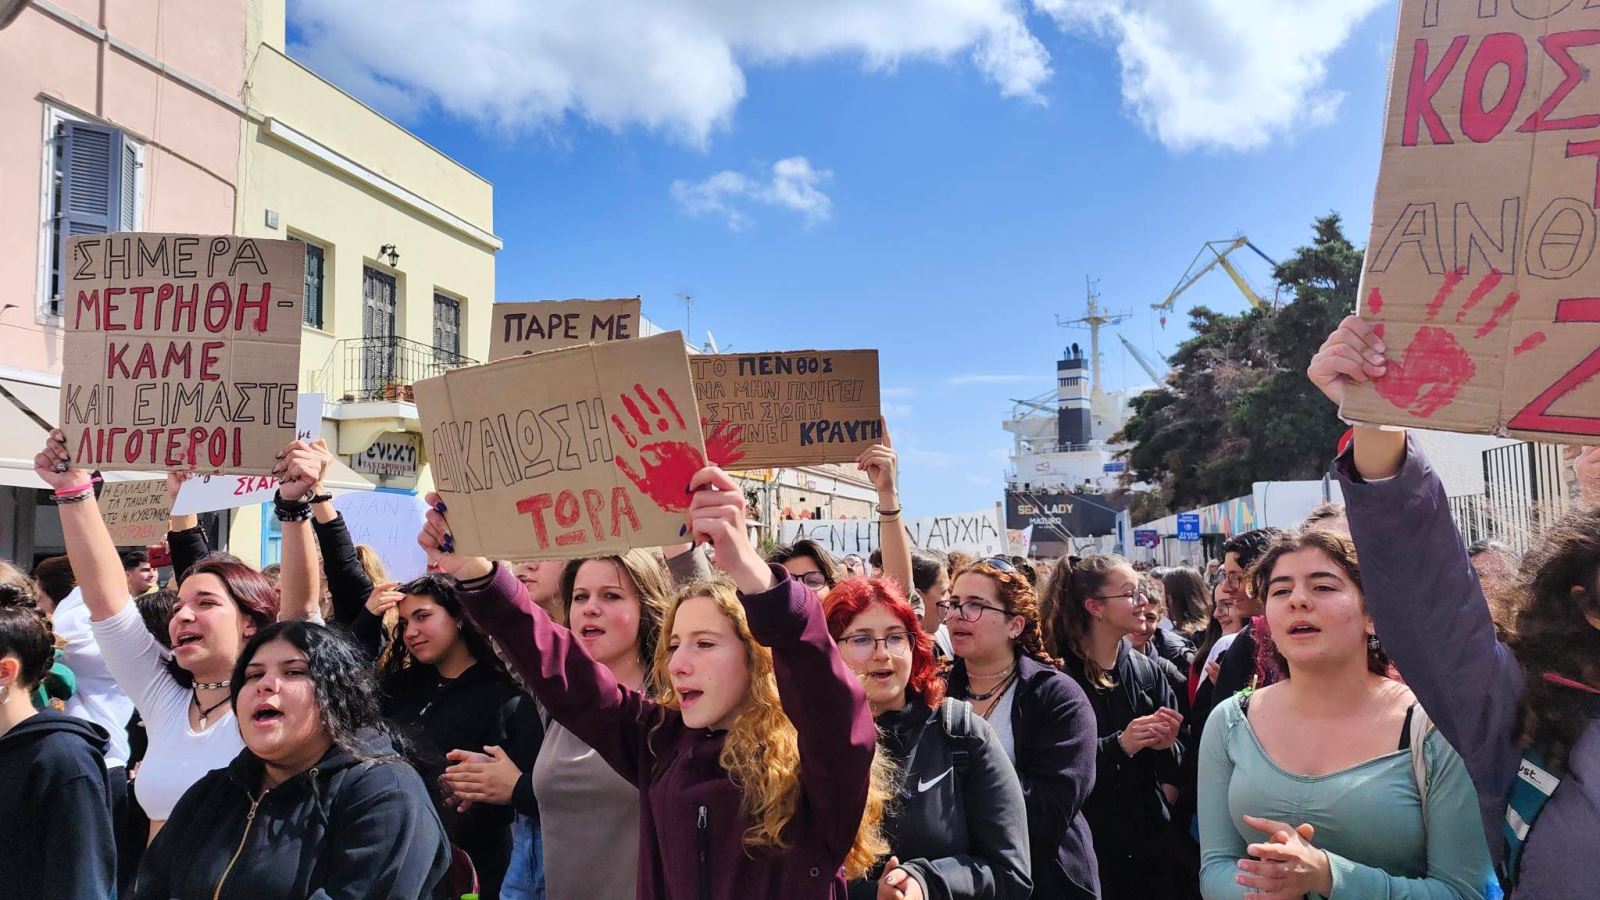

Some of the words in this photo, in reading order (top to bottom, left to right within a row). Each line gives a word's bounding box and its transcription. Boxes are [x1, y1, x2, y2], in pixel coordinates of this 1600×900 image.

[74, 236, 268, 281] ΣΗΜΕΡΑ
[75, 282, 294, 333] ΜΕΤΡΗΘΗ-
[504, 313, 580, 343] ΠΑΡΕ
[590, 313, 632, 340] ΜΕ
[107, 341, 225, 381] ΚΑΜΕ
[690, 358, 727, 379] ΤΟ
[738, 356, 833, 376] ΠΕΝΘΟΣ
[65, 383, 114, 425] ΚΑΙ
[132, 381, 297, 429] ΕΙΜΑΣΤΕ
[695, 381, 726, 400] ΝΑ
[733, 380, 780, 400] ΜΗΝ
[787, 379, 864, 402] ΠΝΙΓΕΙ
[706, 402, 754, 423] ΣΤΗ
[761, 402, 822, 421] ΣΙΩΠΗ
[76, 426, 241, 467] ΛΙΓΟΤΕΡΟΙ
[432, 396, 614, 494] ΔΙΚΑΙΩΣΗ
[800, 418, 882, 446] ΚΡΑΥΓΗ
[516, 486, 642, 550] ΤΩΡΑ
[1017, 504, 1040, 515] SEA
[1044, 503, 1074, 514] LADY
[854, 520, 920, 550] ΗΤΝ
